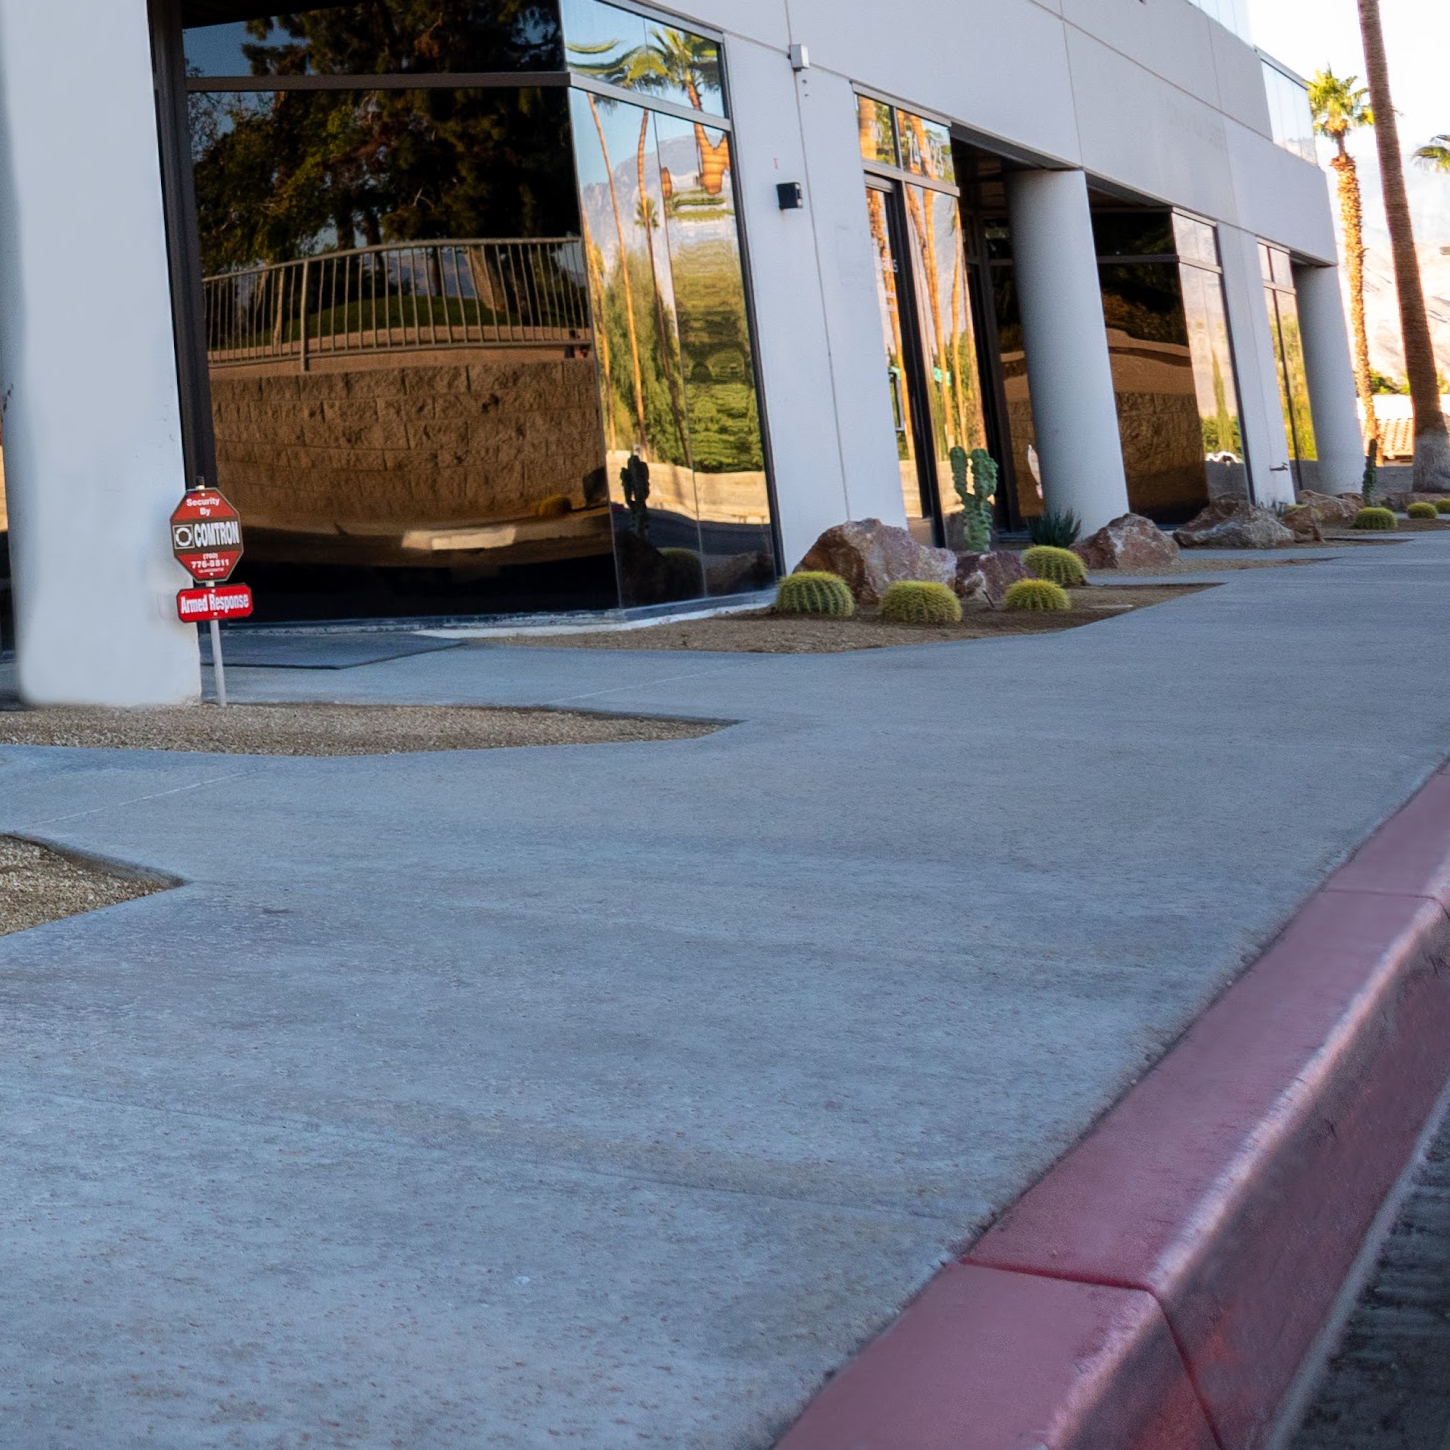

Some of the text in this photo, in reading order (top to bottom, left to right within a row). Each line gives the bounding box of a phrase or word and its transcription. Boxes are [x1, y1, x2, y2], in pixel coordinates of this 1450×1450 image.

[186, 498, 220, 507] Security
[200, 507, 211, 517] By
[193, 521, 240, 548] COMTRON
[181, 593, 249, 614] Armed Response
